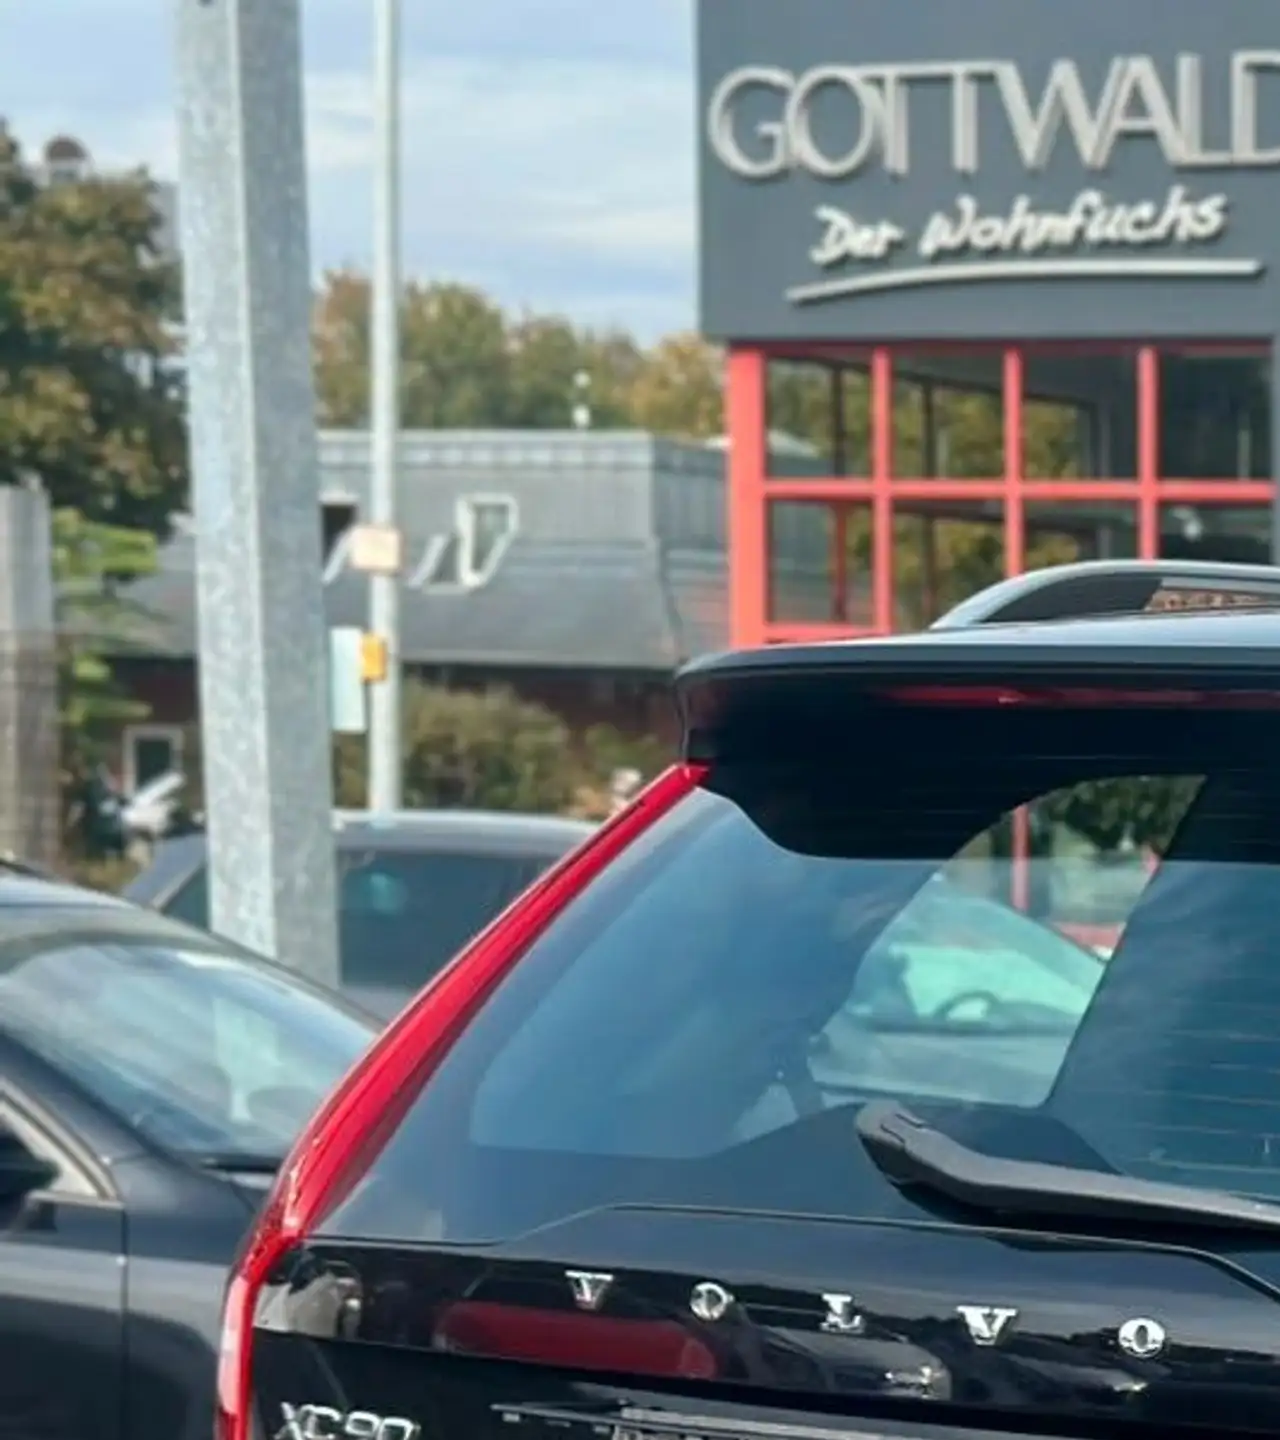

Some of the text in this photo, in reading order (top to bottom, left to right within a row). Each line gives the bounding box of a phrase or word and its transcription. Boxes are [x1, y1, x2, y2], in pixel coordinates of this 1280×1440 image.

[811, 186, 1229, 265] Der Wohnfuchs
[565, 1269, 1166, 1359] VOLVO
